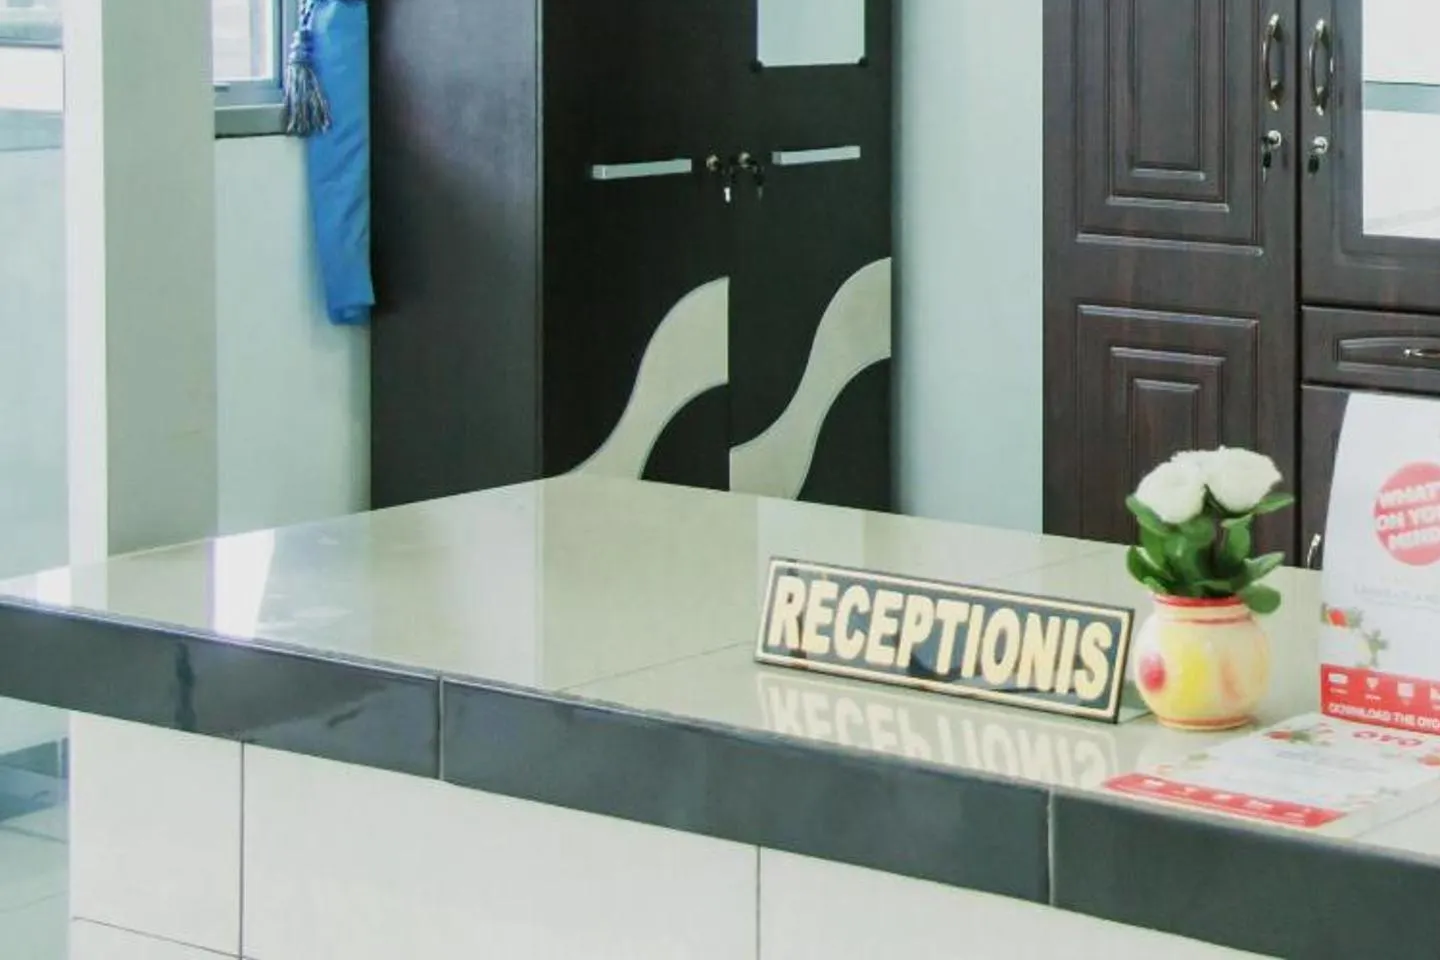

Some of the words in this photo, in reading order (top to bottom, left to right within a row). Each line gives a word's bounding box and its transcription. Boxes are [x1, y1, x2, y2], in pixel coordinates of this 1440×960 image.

[1375, 510, 1405, 531] ON
[767, 574, 1112, 701] RECEPTIONIS
[1393, 711, 1415, 726] THE
[1417, 716, 1440, 729] OYO
